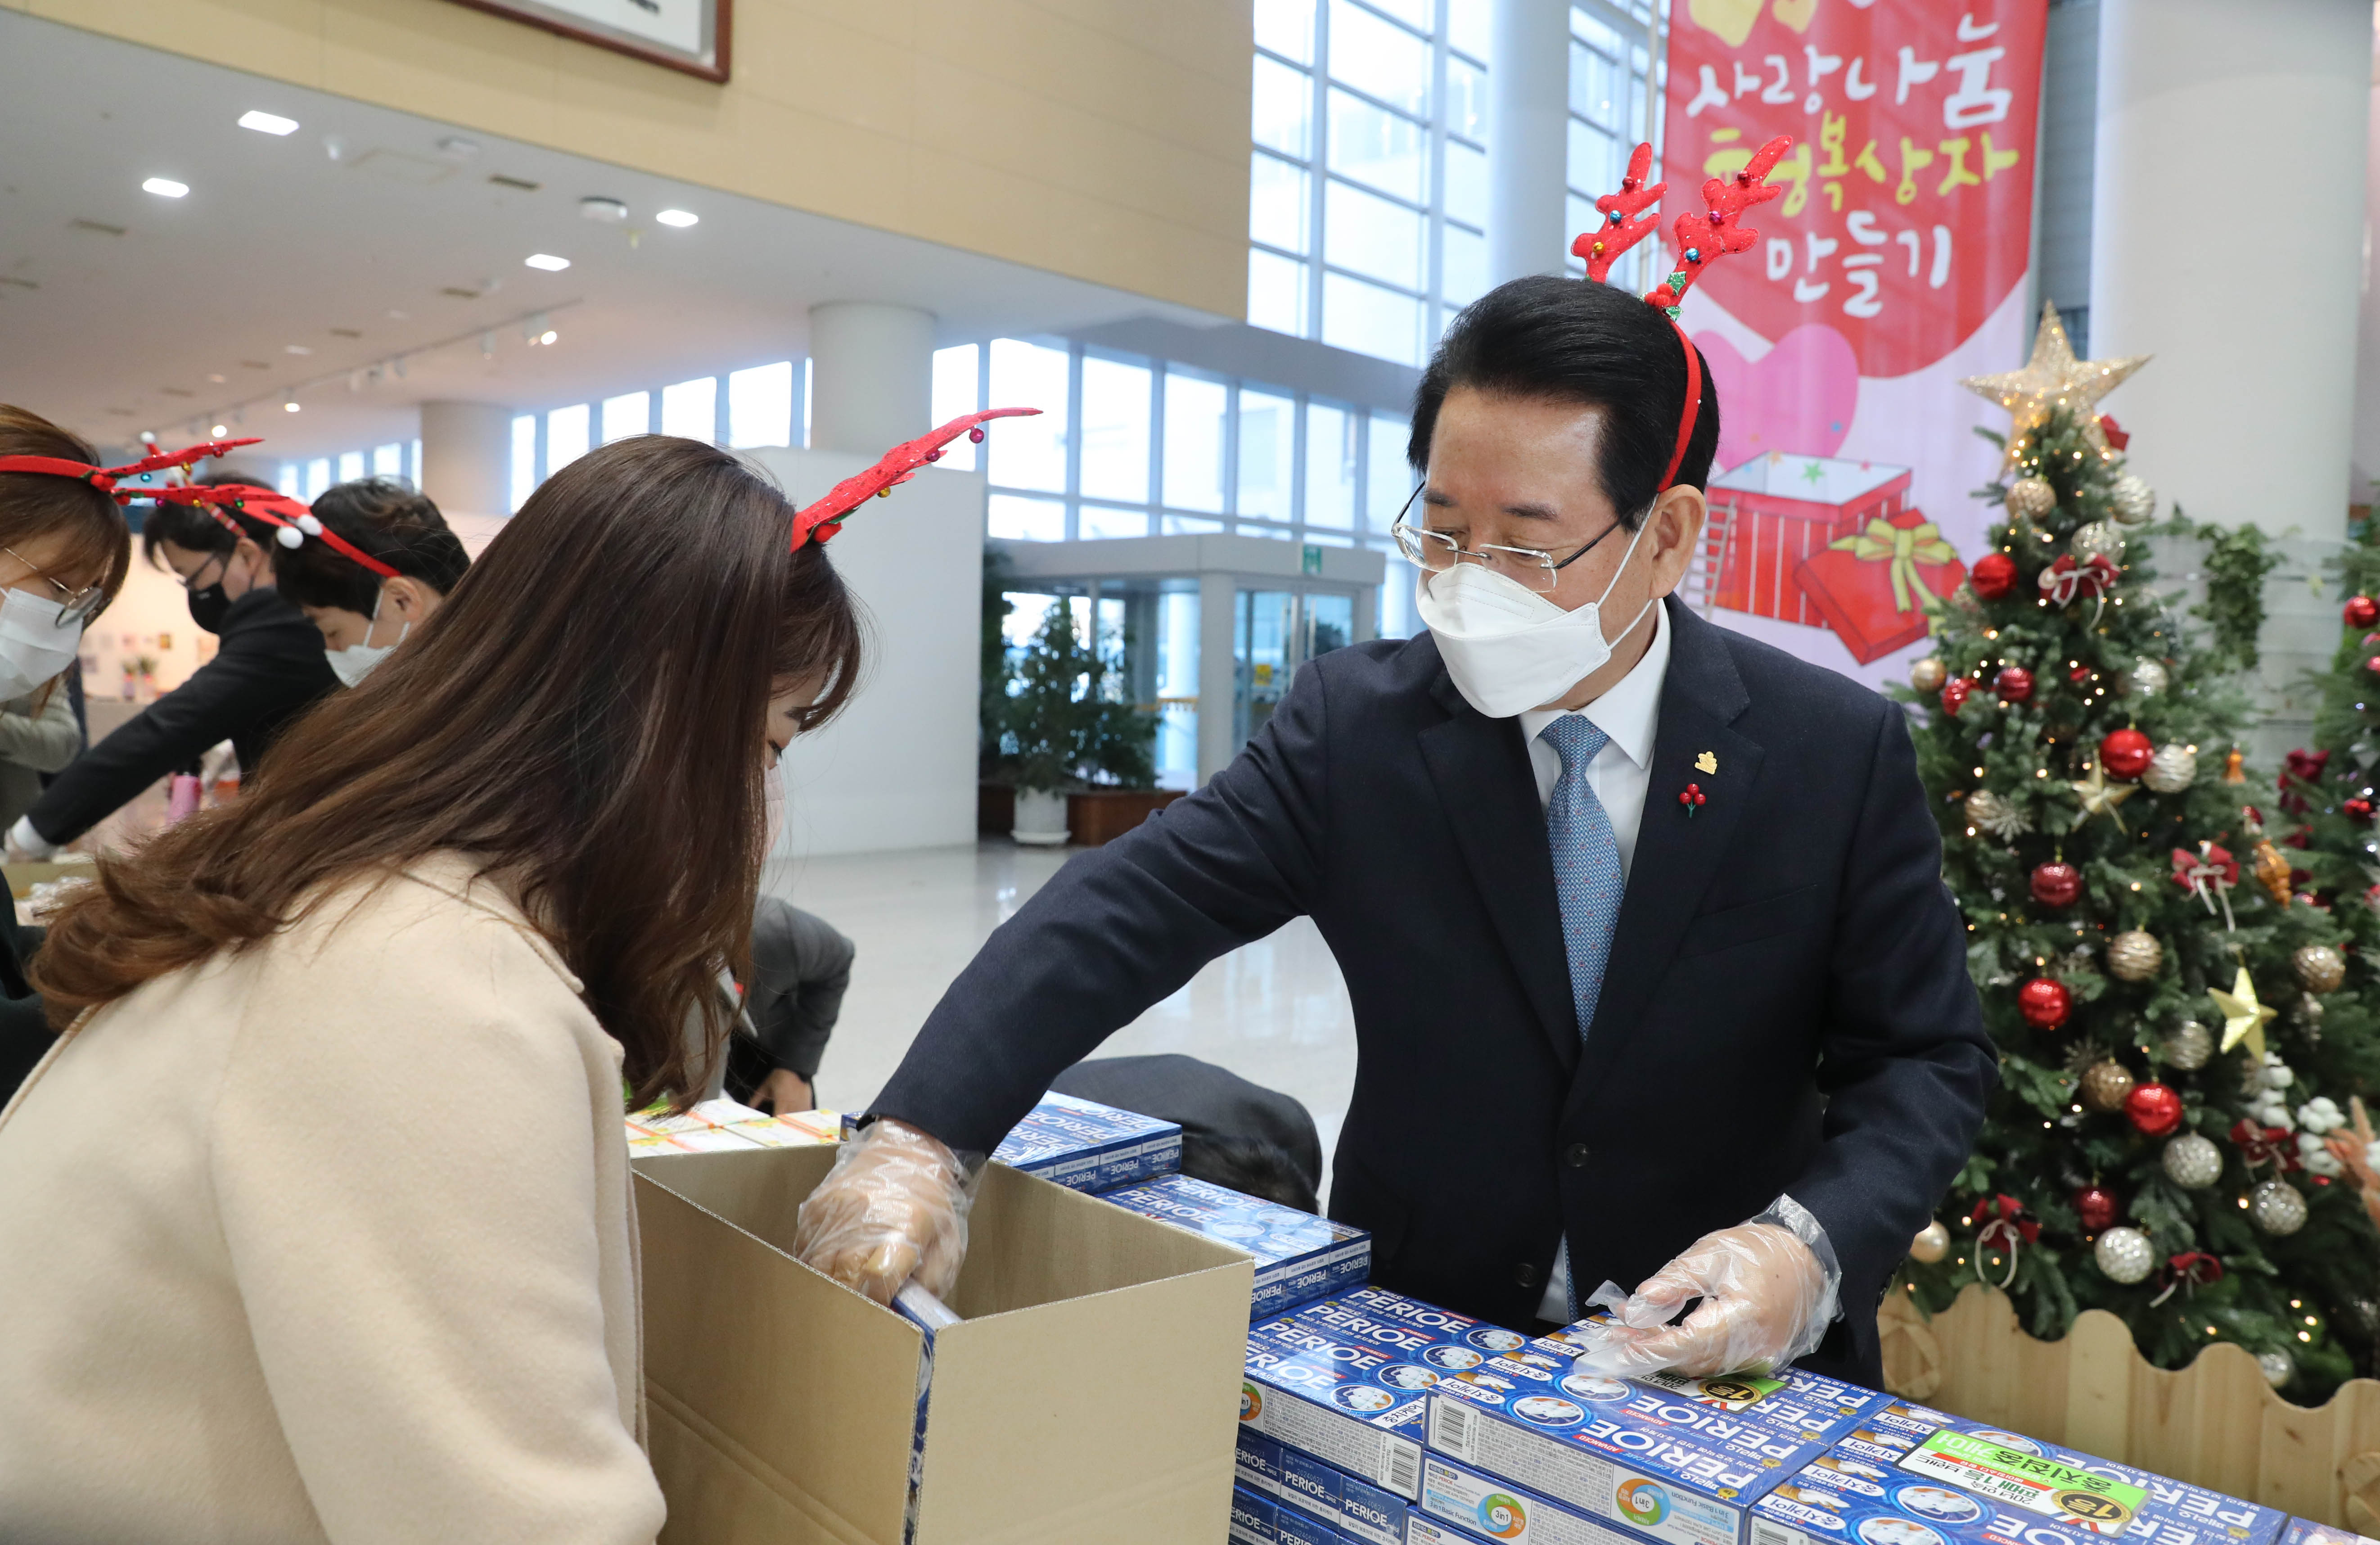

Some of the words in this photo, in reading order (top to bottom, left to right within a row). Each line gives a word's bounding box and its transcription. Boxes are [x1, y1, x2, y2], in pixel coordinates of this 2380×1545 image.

[1685, 13, 2013, 130] 사랑나눔
[1767, 210, 1952, 318] 만들기
[1025, 1112, 1115, 1140] PERIOE
[1152, 1148, 1179, 1164] PERIOE
[1110, 1158, 1139, 1175] PERIOE
[1066, 1170, 1096, 1185] PERIOE
[1160, 1179, 1262, 1212] PERIOE
[1116, 1189, 1221, 1224] PERIOE
[1340, 1256, 1368, 1274] PERIOE
[1296, 1269, 1326, 1289] PERIOE
[1251, 1284, 1282, 1304] PERIOE
[1348, 1289, 1472, 1334] PERIOE
[1444, 1311, 1474, 1323] ADVANCED
[1303, 1305, 1430, 1351] PERIOE
[1402, 1328, 1432, 1340] ADVANCED
[1257, 1321, 1386, 1371] PERIOE
[1358, 1346, 1389, 1359] ADVANCED
[1540, 1340, 1578, 1354] 치케어
[1245, 1346, 1339, 1390] ERIOE
[1495, 1360, 1546, 1380] 충치케어
[1447, 1382, 1499, 1403] 충치케어
[1653, 1379, 1681, 1390] 20년
[1709, 1386, 1751, 1400] 1등
[1683, 1402, 1719, 1416] 충치케어
[1804, 1396, 1839, 1409] 페리오
[1382, 1404, 1424, 1423] 충치케어
[1625, 1409, 1665, 1425] ADVANCED
[1719, 1414, 1740, 1423] 의한
[1749, 1399, 1837, 1432] PER
[1627, 1395, 1799, 1459] PERIOE
[1670, 1425, 1690, 1434] CARE
[1740, 1420, 1777, 1435] 보호막에
[1766, 1417, 1803, 1433] 페리오
[1884, 1414, 1931, 1433] 치케어
[1639, 1427, 1676, 1442] 충치케어
[1778, 1433, 1806, 1445] 알칼리
[1578, 1435, 1619, 1452] ADVANCED
[1677, 1440, 1697, 1449] 의한
[1725, 1442, 1763, 1461] 페리오
[1849, 1440, 1895, 1460] 치케어
[1235, 1447, 1266, 1472] ERIOE
[1580, 1419, 1758, 1489] PERIOE
[1623, 1452, 1643, 1461] CARE
[1698, 1447, 1735, 1463] 보호막에
[1643, 1459, 1670, 1470] CAVITY
[1736, 1460, 1766, 1473] 알칼리
[1915, 1454, 1962, 1473] 브랜드
[1959, 1460, 1979, 1468] 함유
[2105, 1462, 2149, 1477] 충치케어
[1297, 1468, 1324, 1485] 20240623
[1439, 1476, 1453, 1485] PERIOE
[1680, 1471, 1720, 1491] 페리오
[1811, 1468, 1878, 1494] 충치케어
[1962, 1470, 1993, 1484] 1등
[1979, 1467, 2024, 1483] 베이킹소다
[2151, 1474, 2174, 1486] 의한
[1285, 1470, 1325, 1499] PERIOE
[1970, 1481, 1997, 1495] 연속
[1998, 1480, 2040, 1500] 판매
[2177, 1482, 2222, 1500] 보호막에
[1357, 1495, 1385, 1513] 20240623
[1671, 1491, 1697, 1506] Function
[1999, 1491, 2033, 1505] 20년
[2225, 1497, 2261, 1512] 알칼리
[1345, 1498, 1388, 1527] PERIOE
[1698, 1501, 1714, 1513] Basic
[1770, 1499, 1838, 1529] 충치케어
[2067, 1498, 2114, 1518] 1등
[1231, 1506, 1261, 1530] ERIOE
[1442, 1506, 1455, 1516] Basic
[1455, 1512, 1476, 1526] Function
[2152, 1513, 2199, 1532] 보호막에
[2177, 1508, 2226, 1530] 페리오
[1292, 1527, 1319, 1545] 20240623
[1422, 1534, 1436, 1543] PERIOE
[1988, 1534, 2019, 1545] ANCED
[2049, 1522, 2095, 1540] 충치케어
